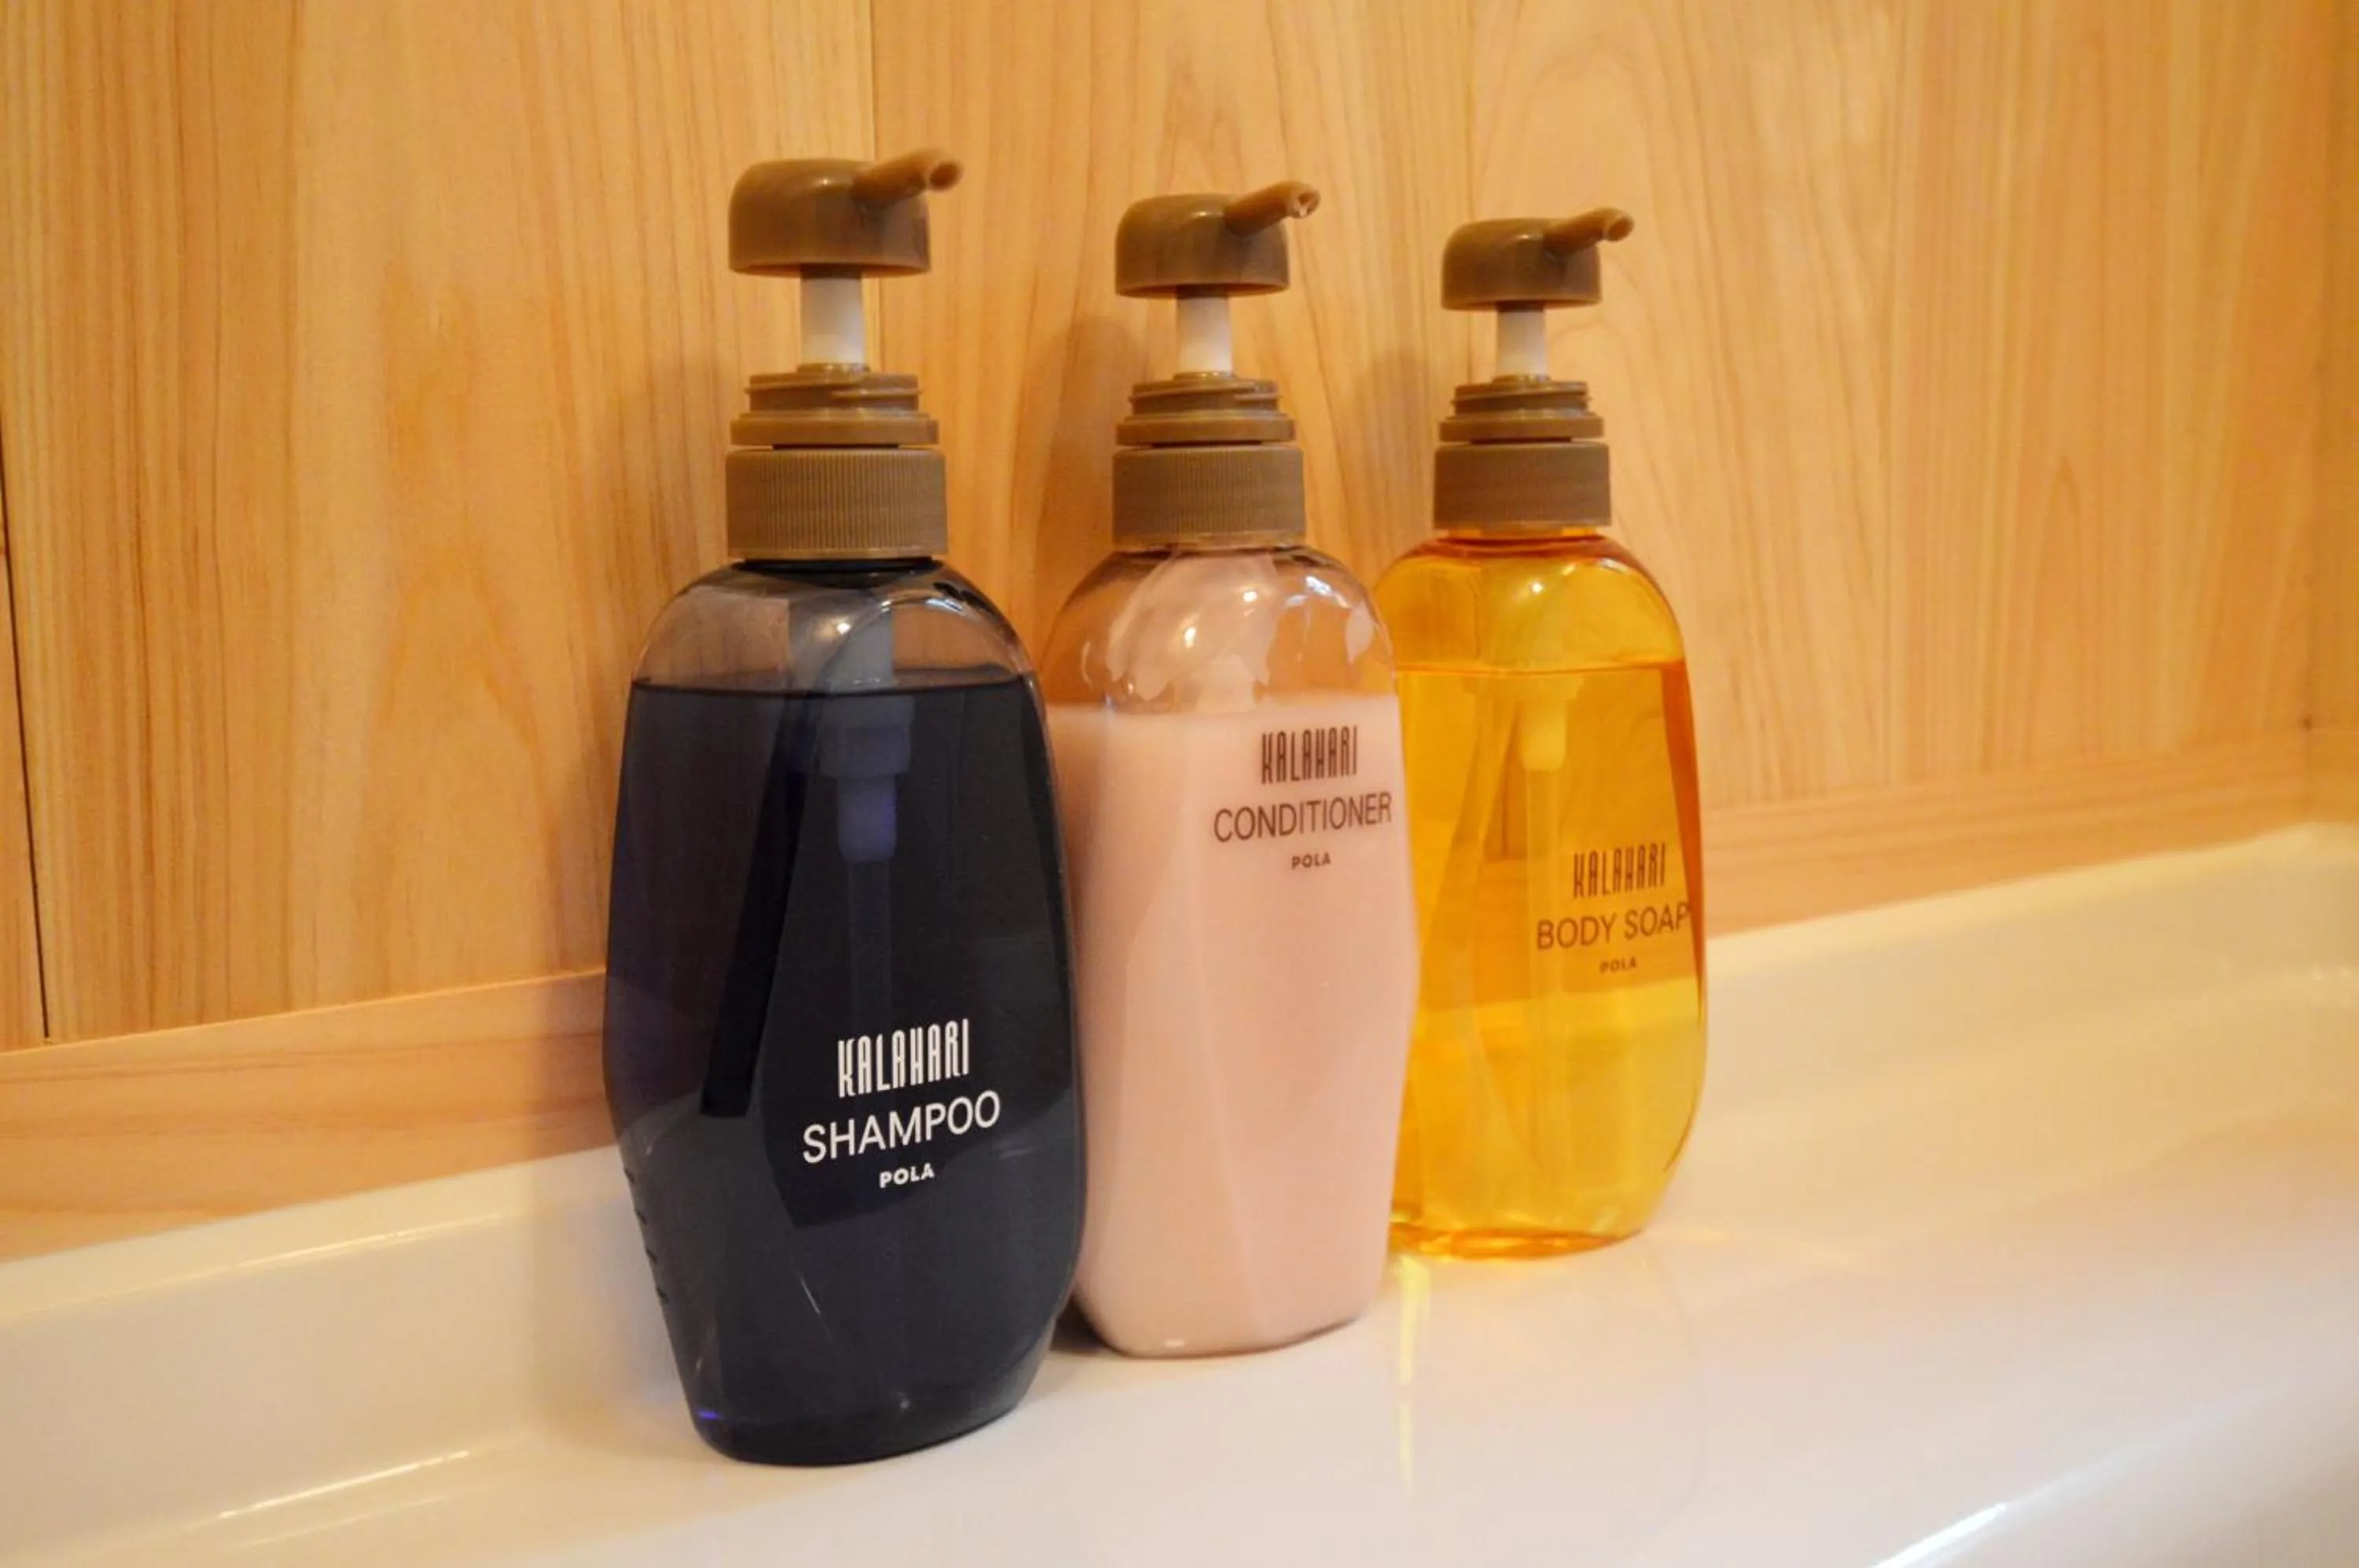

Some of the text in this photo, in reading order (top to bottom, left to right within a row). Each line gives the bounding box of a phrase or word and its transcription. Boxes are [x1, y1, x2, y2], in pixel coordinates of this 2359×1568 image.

[1260, 724, 1357, 785] KALAHARI
[1213, 792, 1393, 843] CONDITIONER
[1291, 852, 1331, 870] POLA
[1573, 841, 1665, 899] KALAHARI
[1536, 901, 1691, 951] BODY SOAP
[1599, 956, 1637, 974] POLA
[837, 1018, 970, 1099] KALAHARI
[802, 1090, 1001, 1164] SHAMPOO
[879, 1162, 935, 1188] POLA
